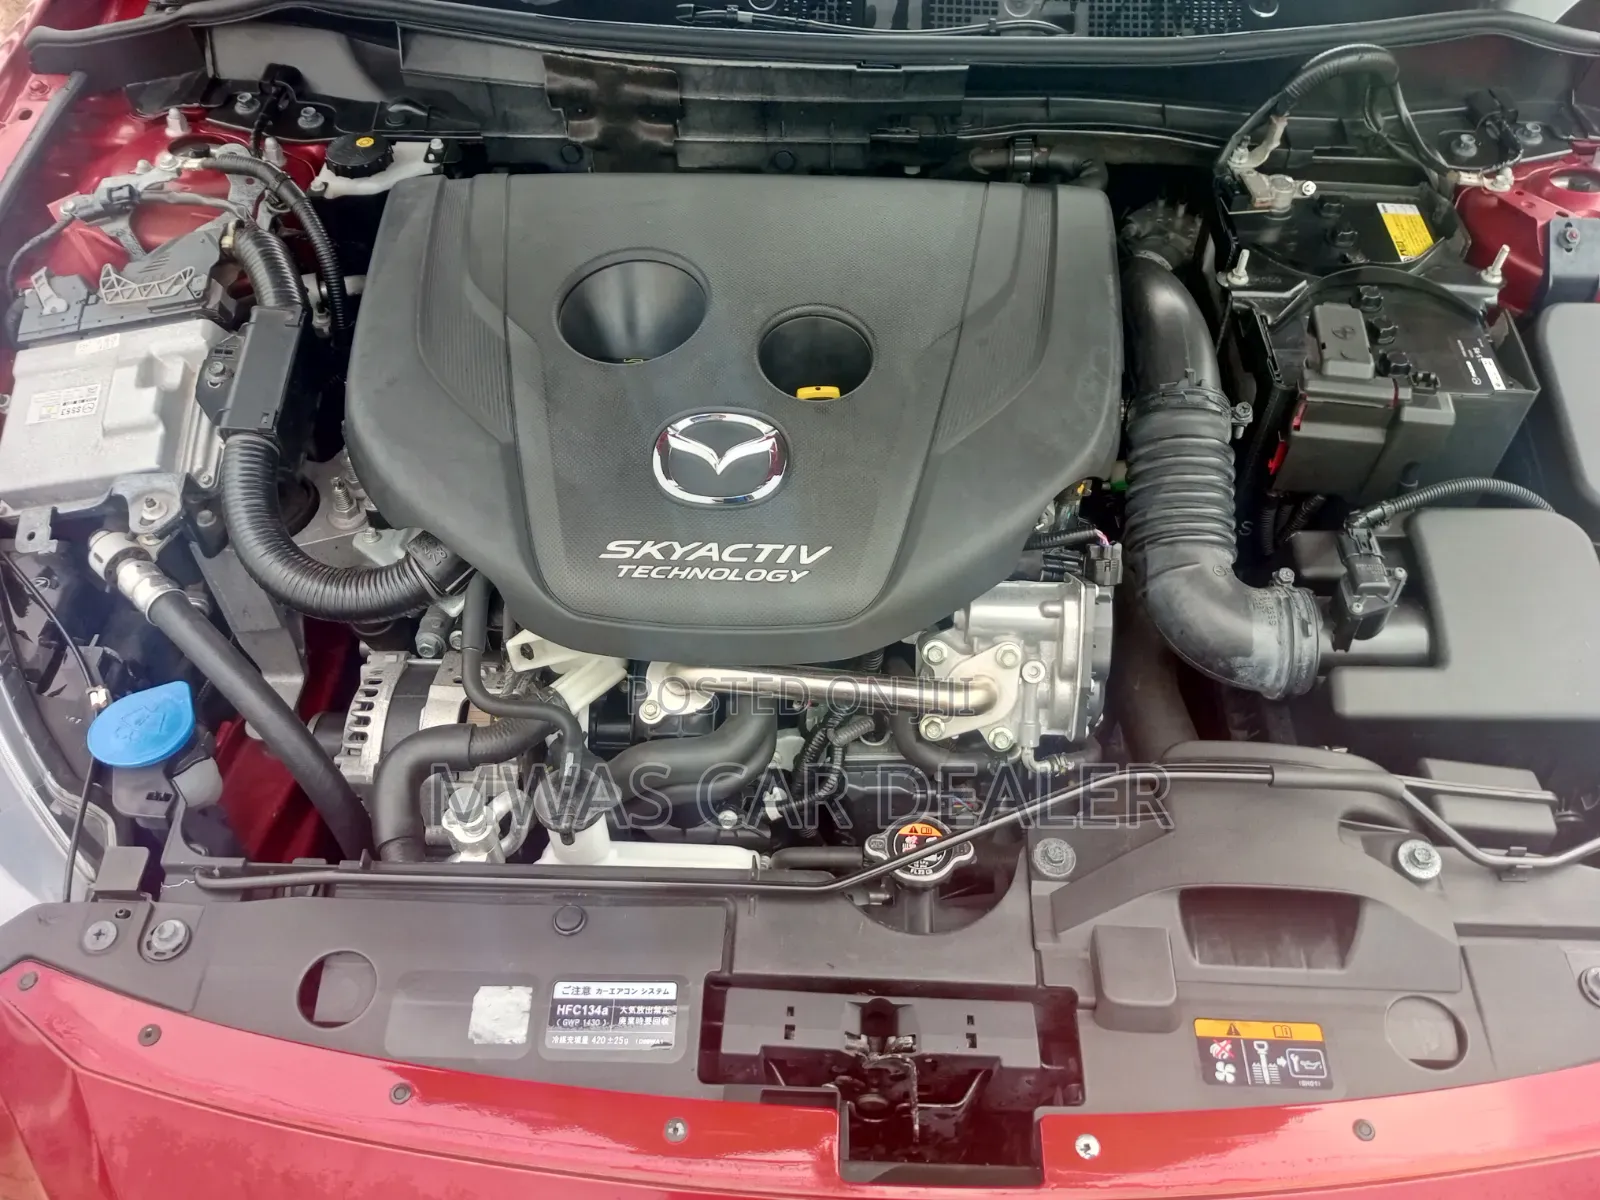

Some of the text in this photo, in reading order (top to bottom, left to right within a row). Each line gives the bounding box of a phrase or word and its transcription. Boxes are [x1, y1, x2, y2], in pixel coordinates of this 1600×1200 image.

[598, 540, 833, 565] SKYACTIV
[616, 564, 810, 583] TECHNOLOGY
[561, 985, 592, 996] ご注意
[556, 1004, 609, 1016] HFC134a
